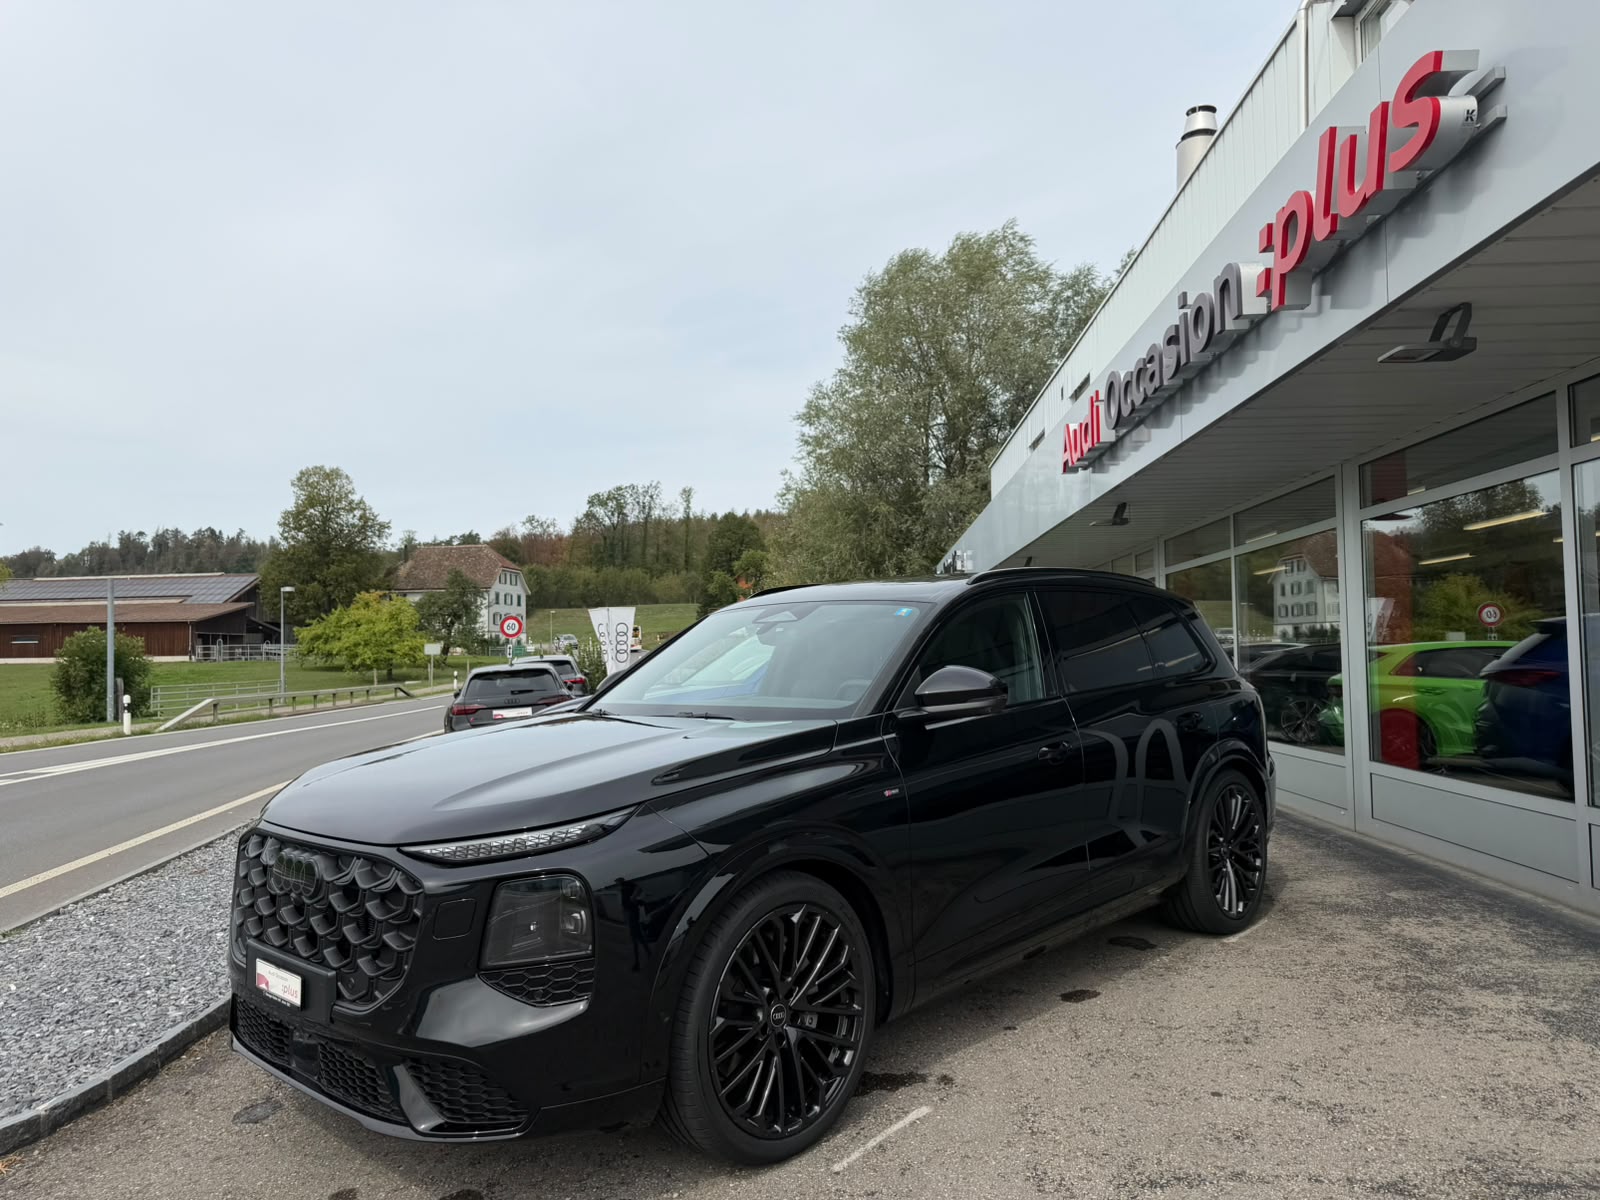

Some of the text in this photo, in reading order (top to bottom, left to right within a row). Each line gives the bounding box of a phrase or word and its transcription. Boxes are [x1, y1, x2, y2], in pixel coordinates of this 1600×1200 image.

[1465, 109, 1476, 122] K
[1062, 50, 1444, 474] Audi Occasion :plus
[506, 622, 516, 631] 60
